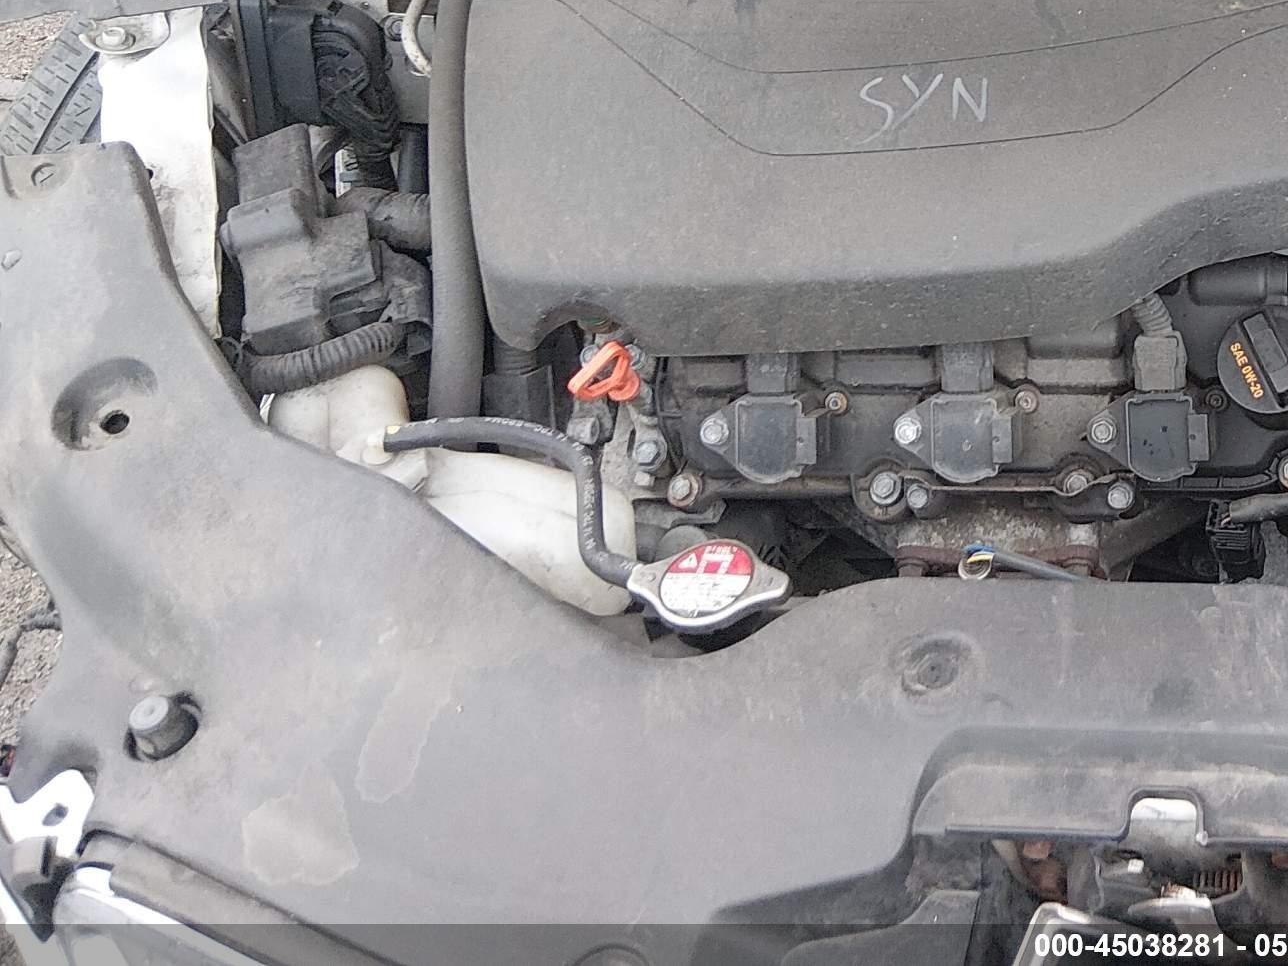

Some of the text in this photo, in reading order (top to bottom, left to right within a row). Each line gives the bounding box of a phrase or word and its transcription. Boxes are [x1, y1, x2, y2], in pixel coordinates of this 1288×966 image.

[859, 73, 988, 144] SYN
[1230, 342, 1264, 398] SAE 0W-20
